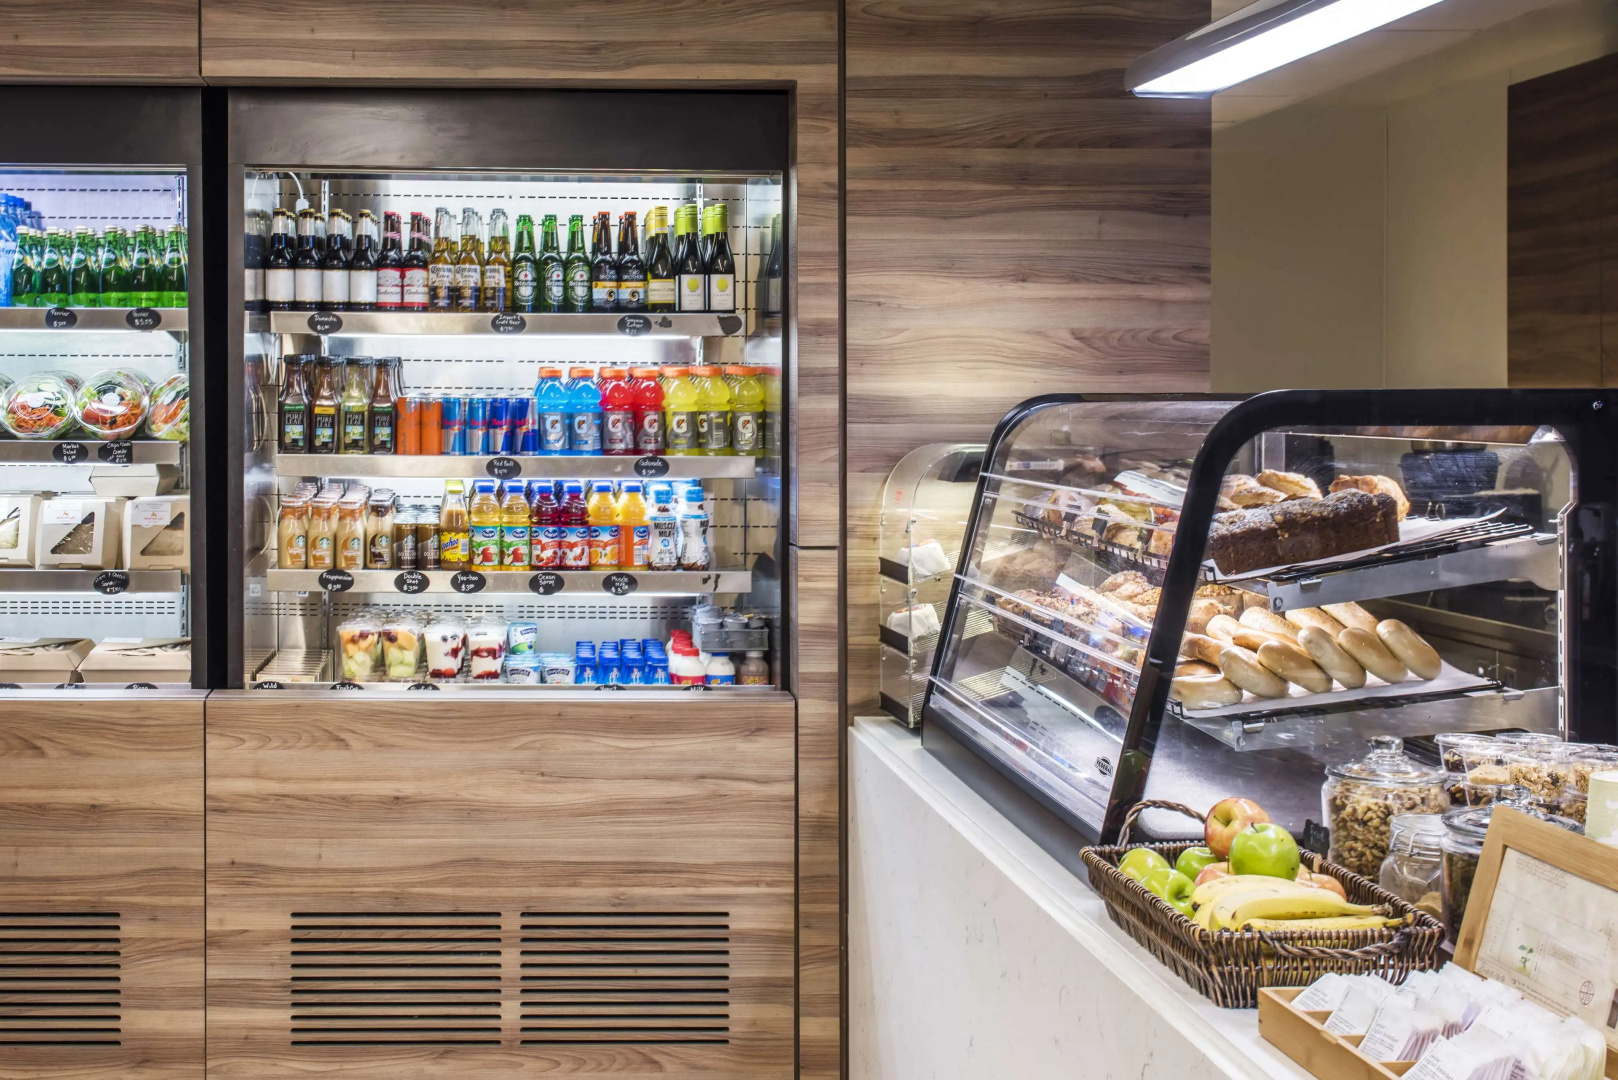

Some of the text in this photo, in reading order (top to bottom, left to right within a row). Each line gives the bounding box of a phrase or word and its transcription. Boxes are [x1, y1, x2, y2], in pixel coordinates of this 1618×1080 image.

[546, 415, 562, 433] G
[574, 416, 588, 434] G
[608, 414, 622, 432] G
[644, 414, 658, 432] G
[672, 414, 688, 433] G
[698, 414, 708, 432] G
[738, 415, 752, 434] G
[654, 522, 676, 530] MUSCLE
